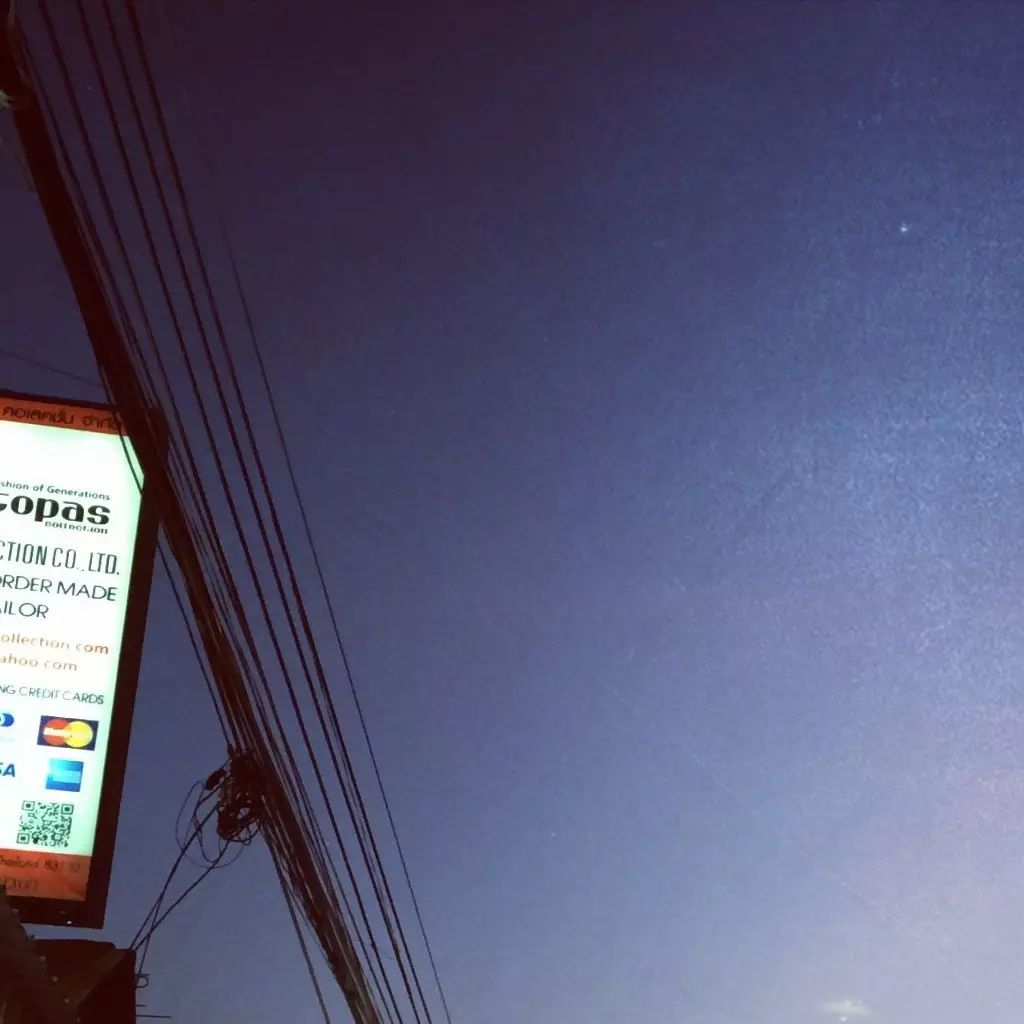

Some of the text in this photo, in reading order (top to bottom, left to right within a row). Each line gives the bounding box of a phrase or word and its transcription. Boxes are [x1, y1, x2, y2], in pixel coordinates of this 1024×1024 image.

[33, 484, 44, 492] of
[47, 485, 110, 500] Generations
[88, 552, 120, 575] LTD.
[0, 574, 118, 601] RDER MADE
[0, 600, 49, 619] ILOR
[19, 686, 60, 699] CREDIT
[62, 690, 105, 705] CARDS
